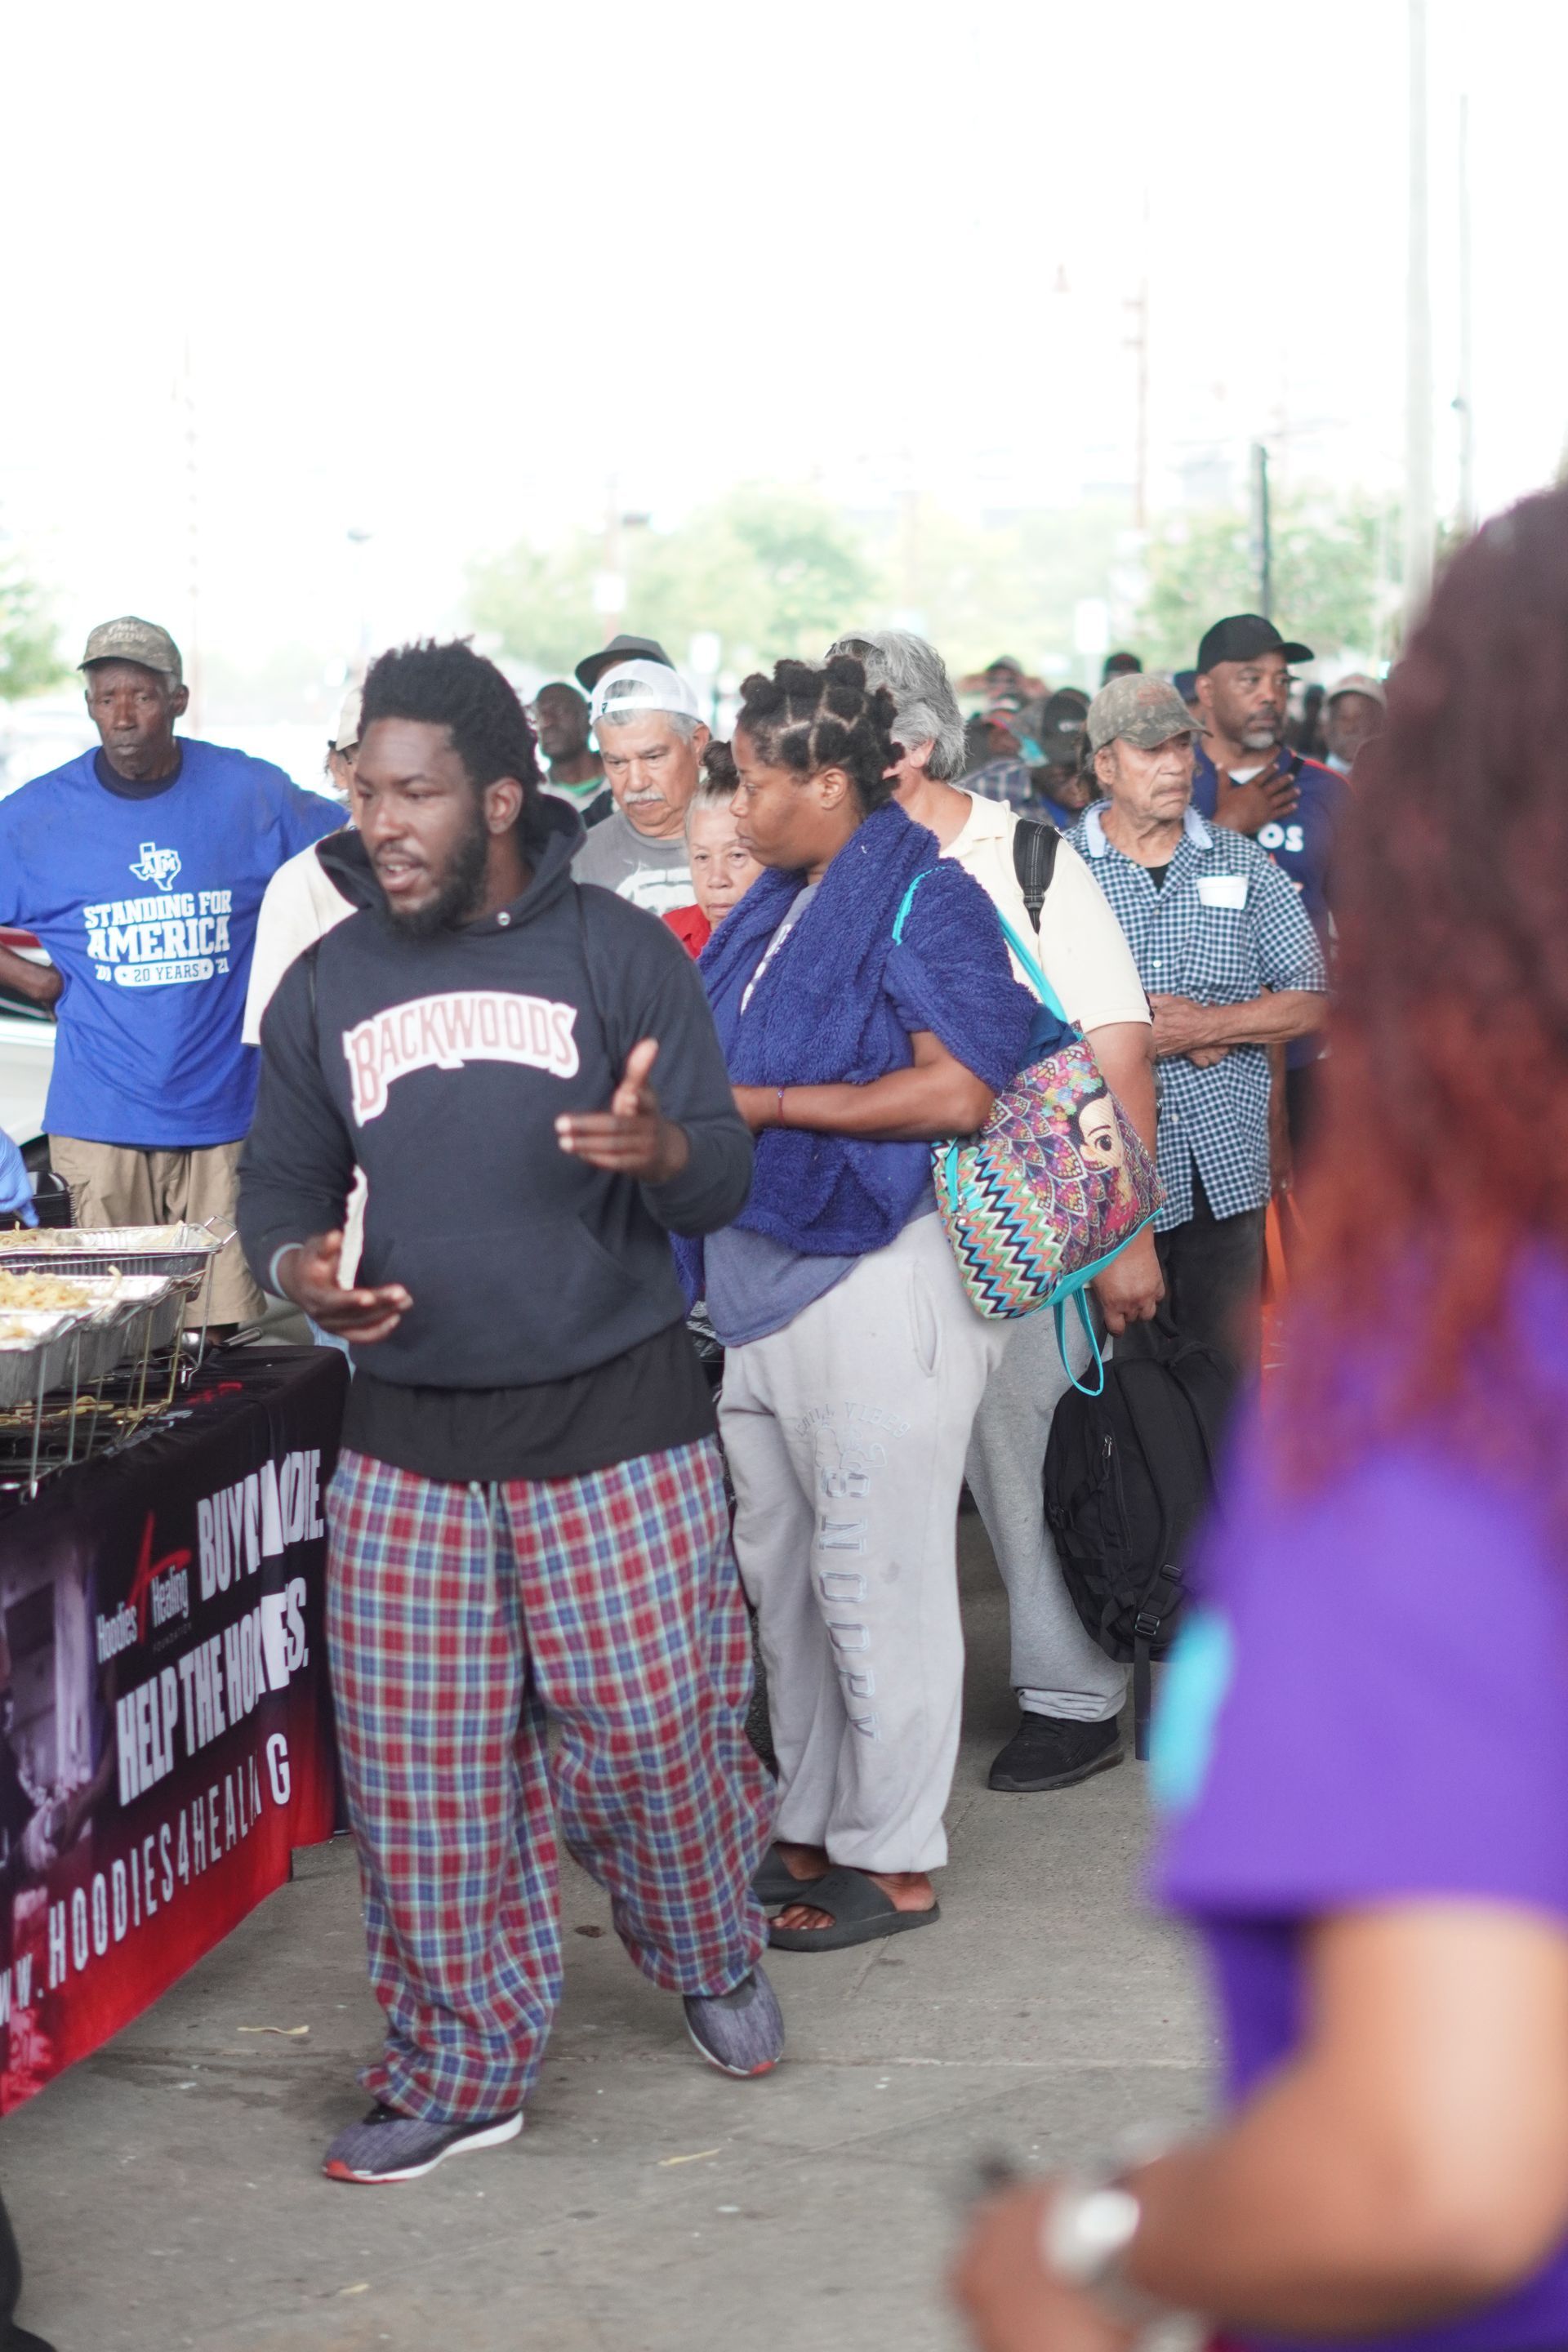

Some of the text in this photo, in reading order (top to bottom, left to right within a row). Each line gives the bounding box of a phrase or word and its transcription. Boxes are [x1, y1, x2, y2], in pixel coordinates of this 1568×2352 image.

[83, 889, 233, 929] STANDING FOR
[87, 915, 231, 964] AMERICA
[134, 969, 150, 982] 20
[156, 963, 200, 981] YEARS
[346, 994, 576, 1116] BACKWOODS
[197, 1481, 245, 1601] BUY
[151, 1564, 189, 1628] Healing
[96, 1601, 138, 1664] Hoodies
[117, 1665, 178, 1807] HELP
[178, 1634, 226, 1757] THE
